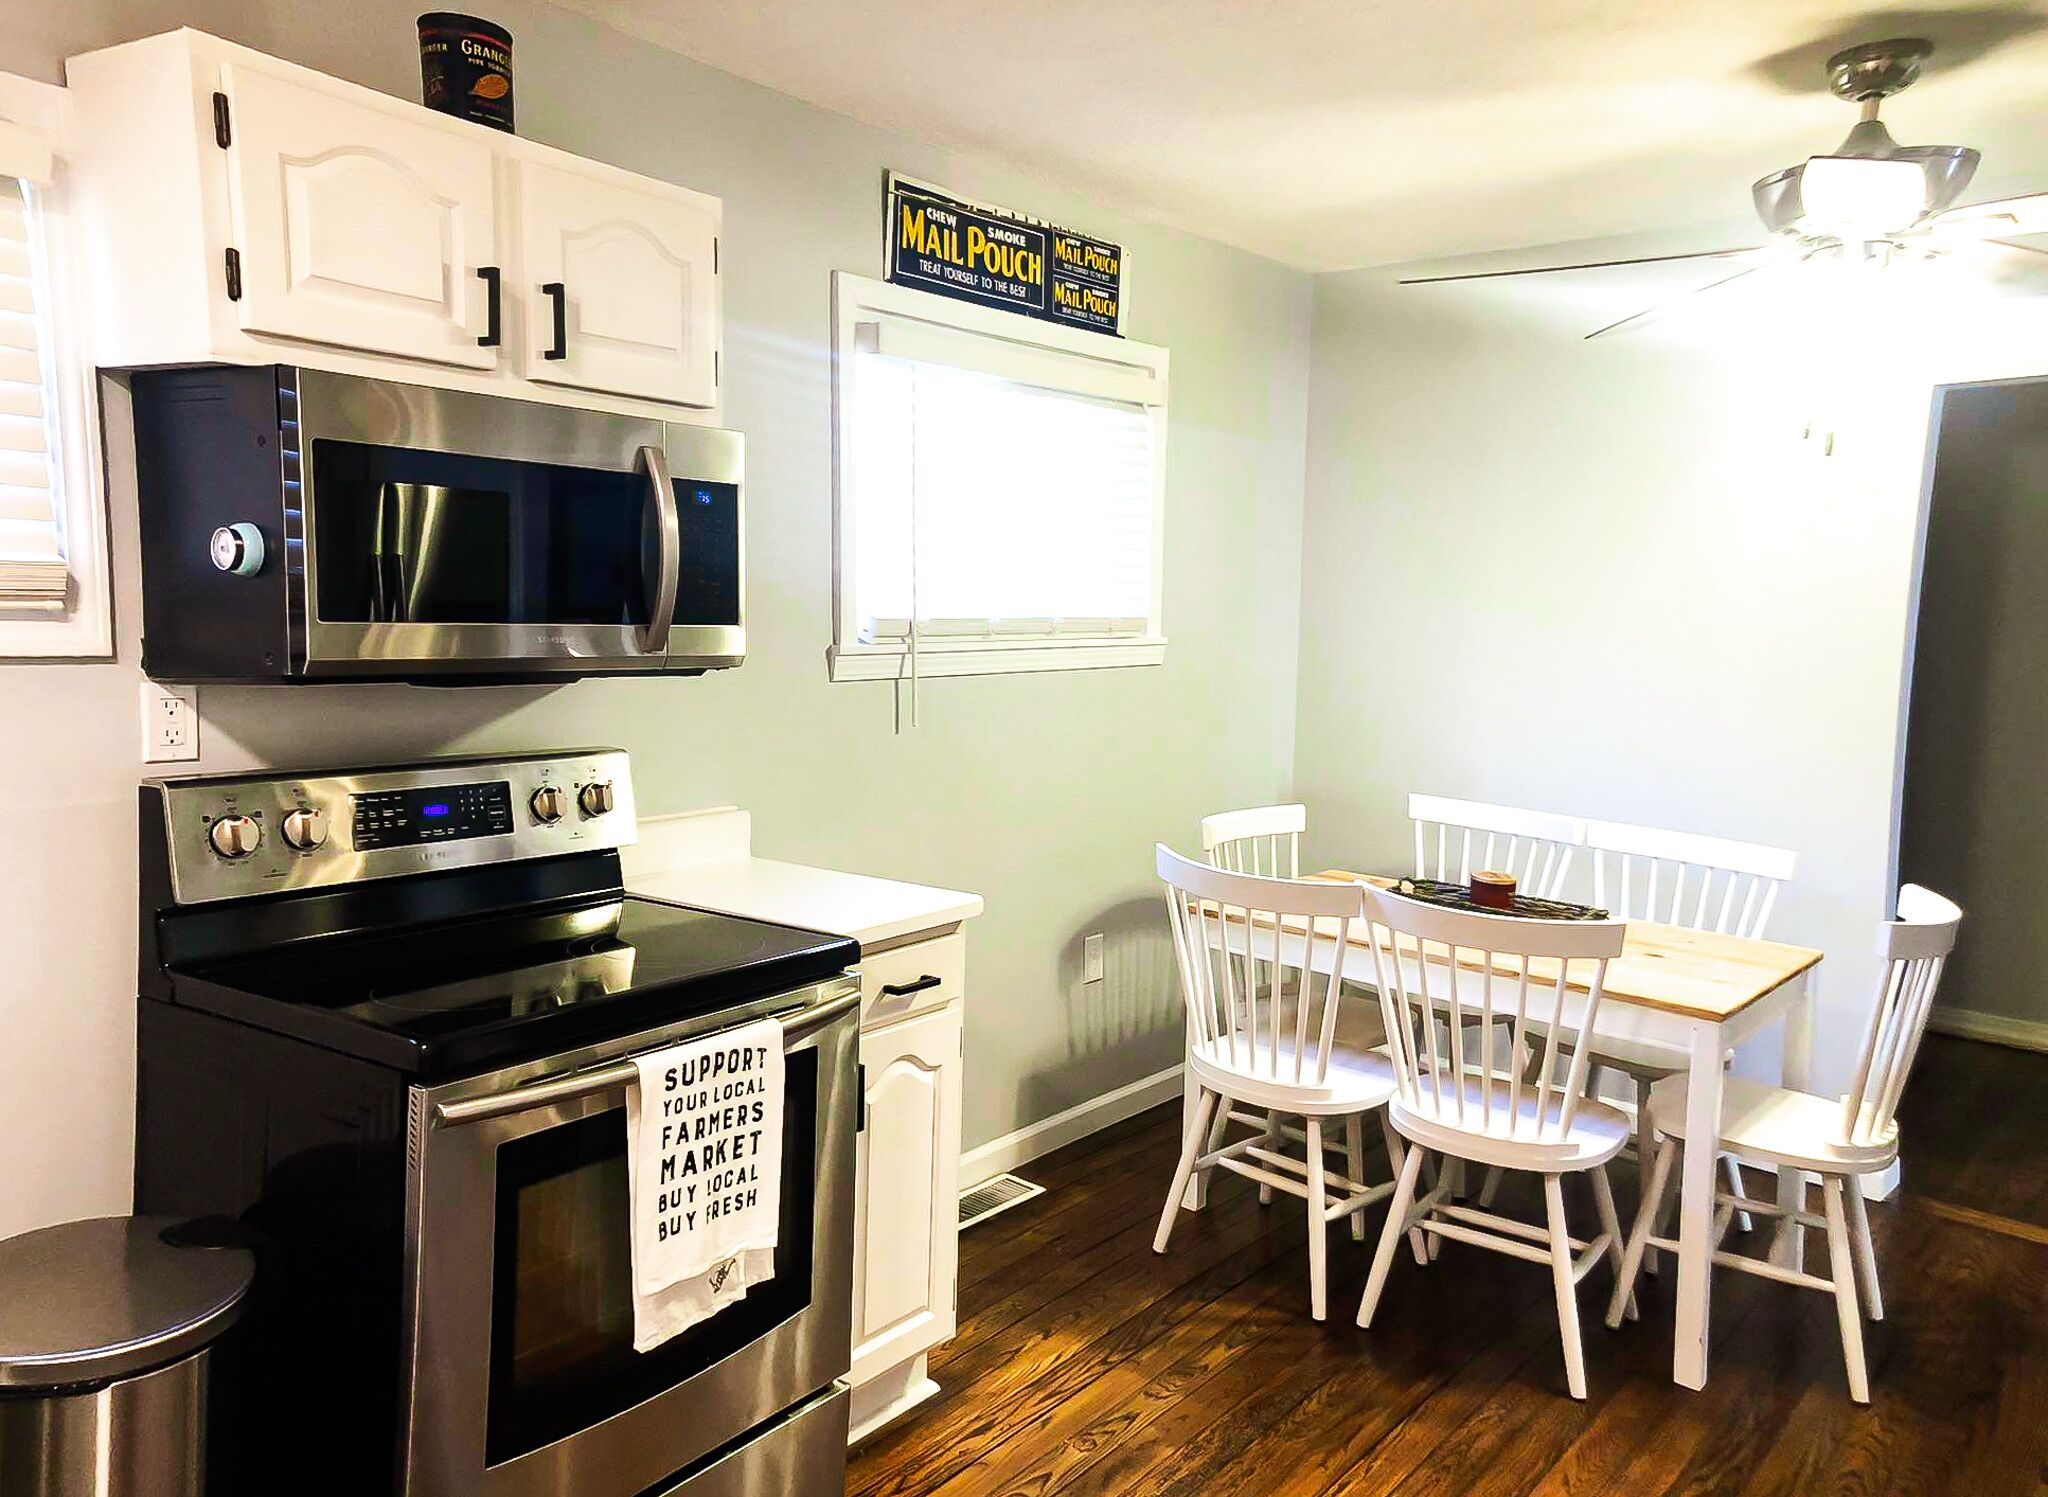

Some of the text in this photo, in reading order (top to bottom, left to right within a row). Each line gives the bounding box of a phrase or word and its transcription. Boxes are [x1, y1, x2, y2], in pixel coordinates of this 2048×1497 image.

[461, 39, 511, 68] GRANG
[926, 207, 957, 230] CHEW
[987, 227, 1026, 247] SMOKE
[902, 204, 1042, 286] MAIL POUCH
[1055, 236, 1083, 266] MAIL
[1084, 246, 1118, 275] POUCH
[919, 259, 1027, 298] TREAT YOURSELF TO THE BEST
[1054, 281, 1082, 309] MAIL
[1083, 289, 1117, 317] POUCH
[665, 1047, 767, 1092] SUPPORT
[663, 1076, 766, 1117] YOUR LOCAL
[662, 1101, 764, 1150] FARMERS
[660, 1130, 763, 1185] MARKET
[658, 1163, 758, 1214] BUY LOCAL
[658, 1188, 757, 1242] BUY FRESH
